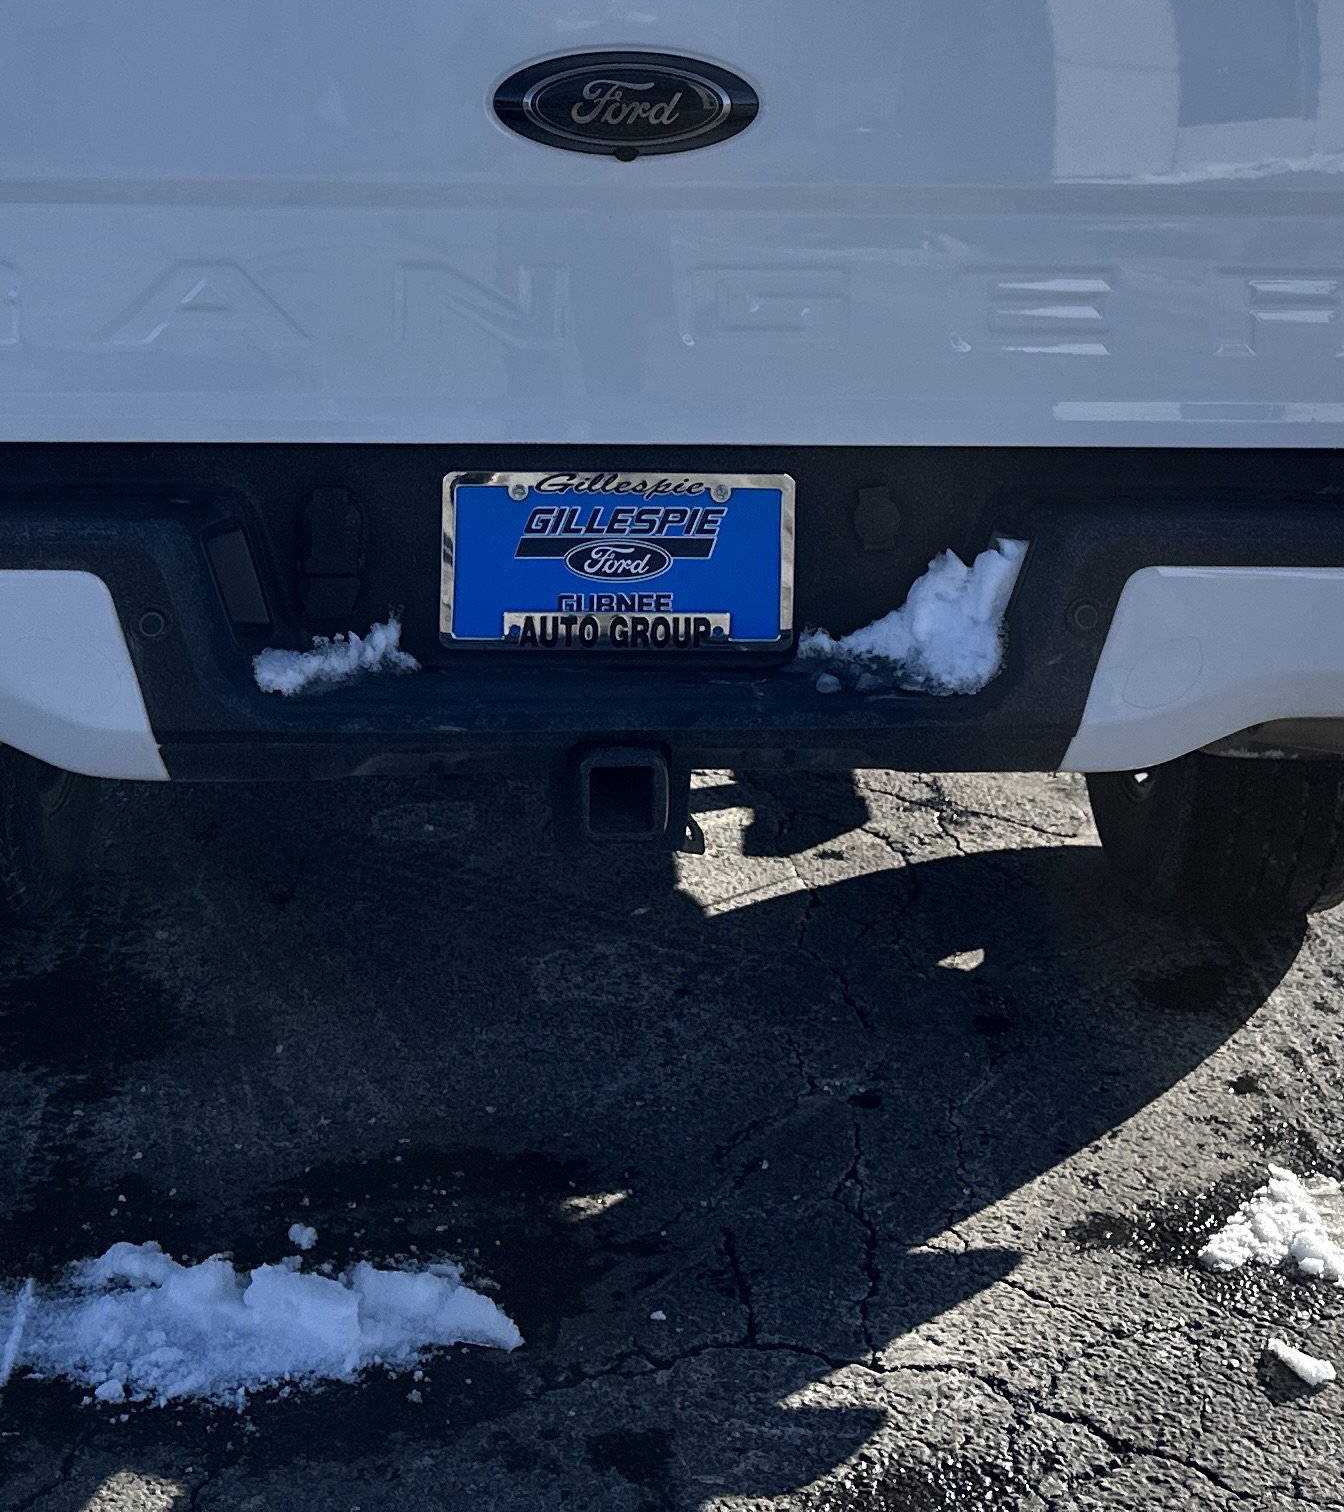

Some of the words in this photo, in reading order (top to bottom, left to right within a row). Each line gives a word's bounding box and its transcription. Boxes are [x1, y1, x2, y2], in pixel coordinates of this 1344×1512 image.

[571, 79, 683, 125] Ford
[534, 473, 706, 501] Gillespie
[523, 506, 729, 536] GILLESPIE
[583, 546, 652, 575] Ford
[557, 592, 674, 612] GURNEE
[519, 614, 600, 648] AUTO
[609, 614, 712, 649] GROUP
